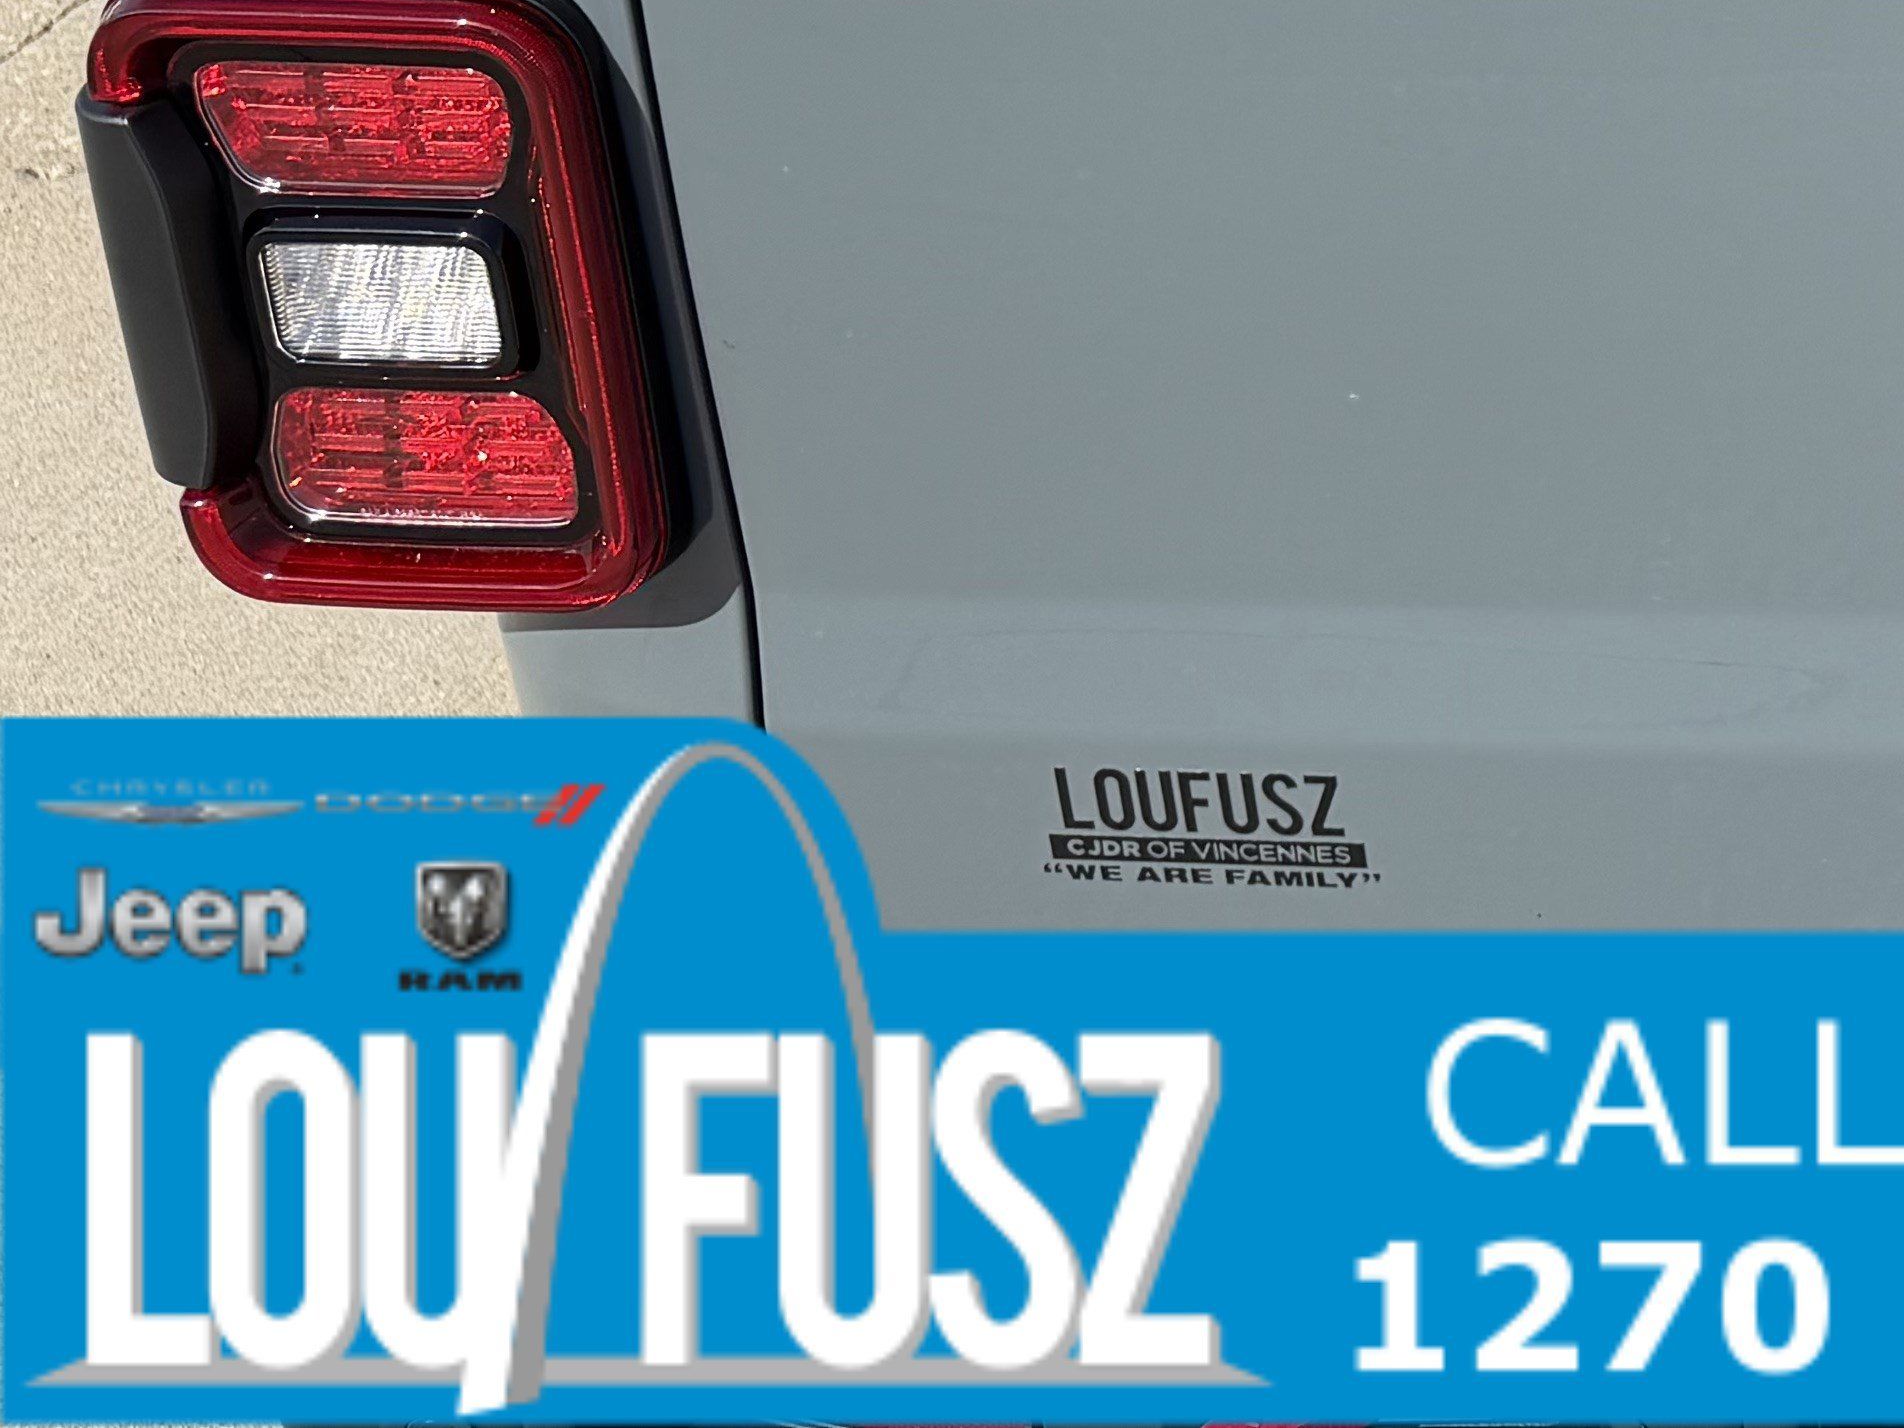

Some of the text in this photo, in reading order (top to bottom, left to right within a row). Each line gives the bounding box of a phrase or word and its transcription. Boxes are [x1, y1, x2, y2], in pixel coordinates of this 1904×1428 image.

[1053, 766, 1346, 838] LOUFUSZ
[1066, 838, 1352, 865] CJDR OF VINCENNES
[1136, 866, 1214, 886] ARE
